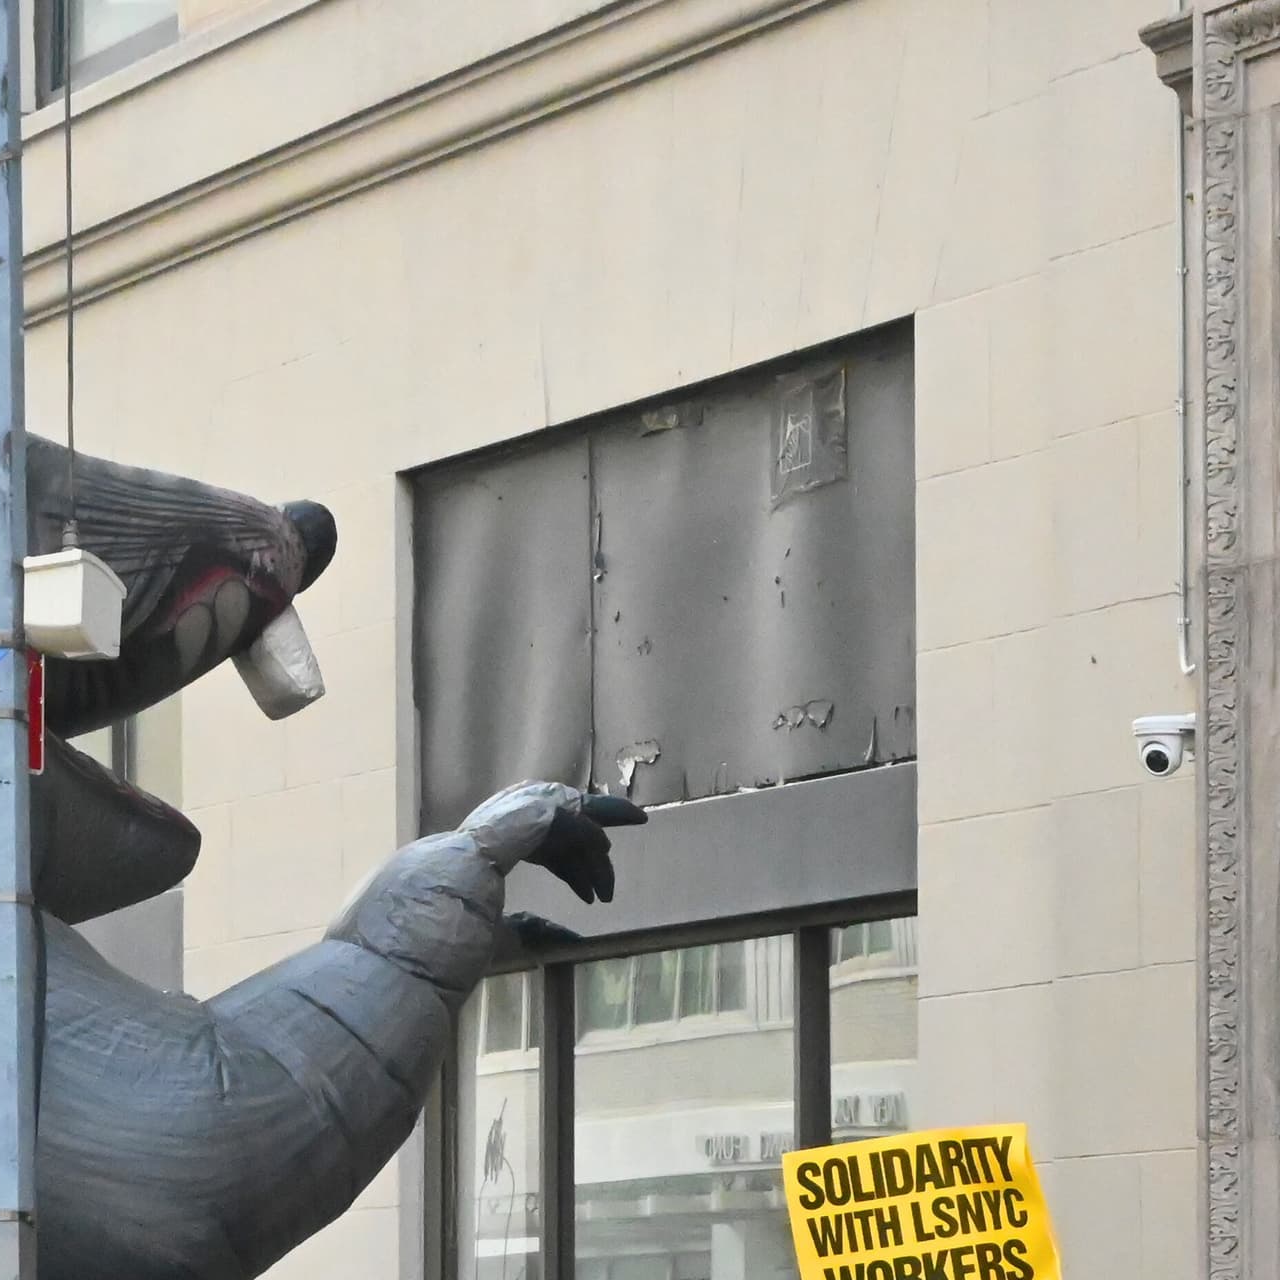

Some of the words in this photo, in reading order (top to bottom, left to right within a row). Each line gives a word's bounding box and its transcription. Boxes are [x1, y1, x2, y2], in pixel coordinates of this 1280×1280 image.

[796, 1136, 1014, 1210] SOLIDARITY
[807, 1205, 904, 1257] WITH
[912, 1188, 1028, 1242] LSNYC
